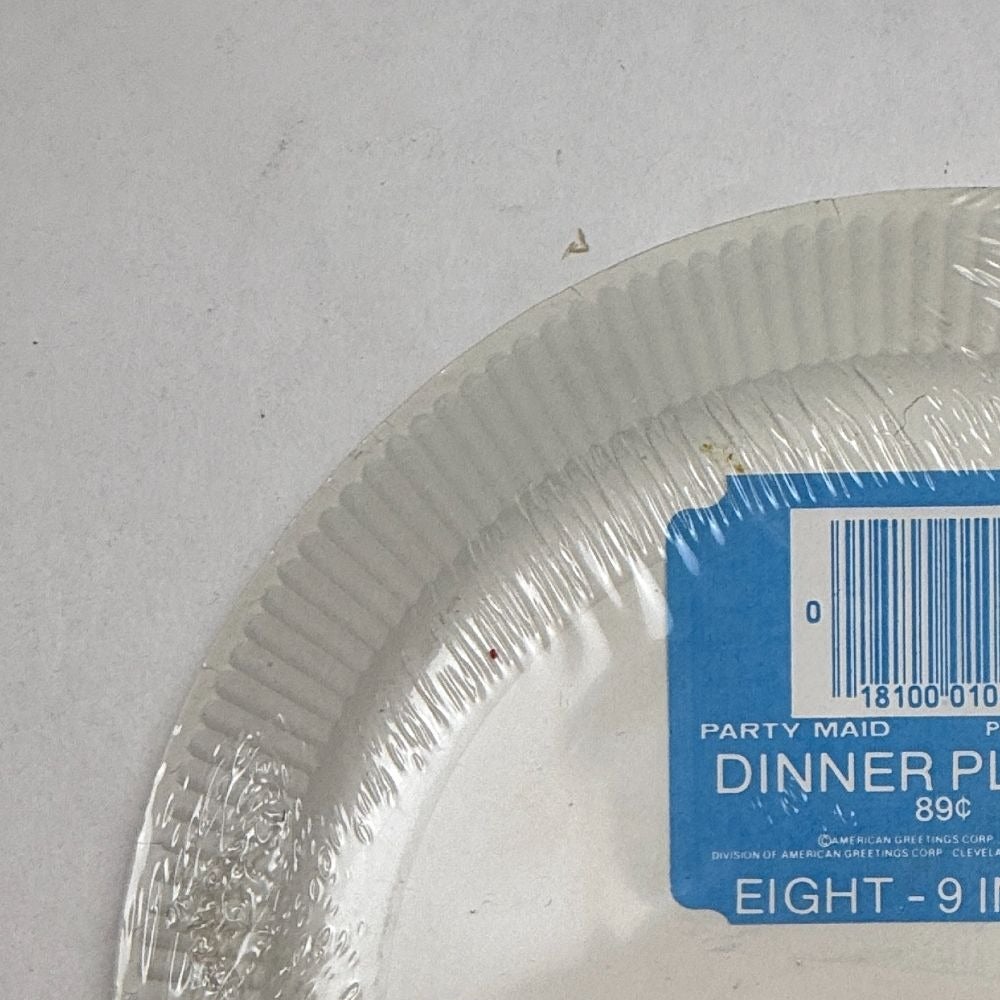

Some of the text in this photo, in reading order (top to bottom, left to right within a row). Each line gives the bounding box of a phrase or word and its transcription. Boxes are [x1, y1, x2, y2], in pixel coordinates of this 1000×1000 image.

[806, 600, 821, 623] 0
[861, 685, 939, 708] 18100
[701, 721, 890, 739] PARTY MAID
[716, 751, 933, 794] DINNER
[915, 796, 972, 821] 89¢
[712, 850, 760, 860] DIVISION
[763, 850, 776, 859] OF
[782, 849, 841, 859] AMERICAN
[844, 849, 908, 858] GREETINGS
[736, 877, 893, 914] EIGHT
[937, 876, 962, 914] 9
